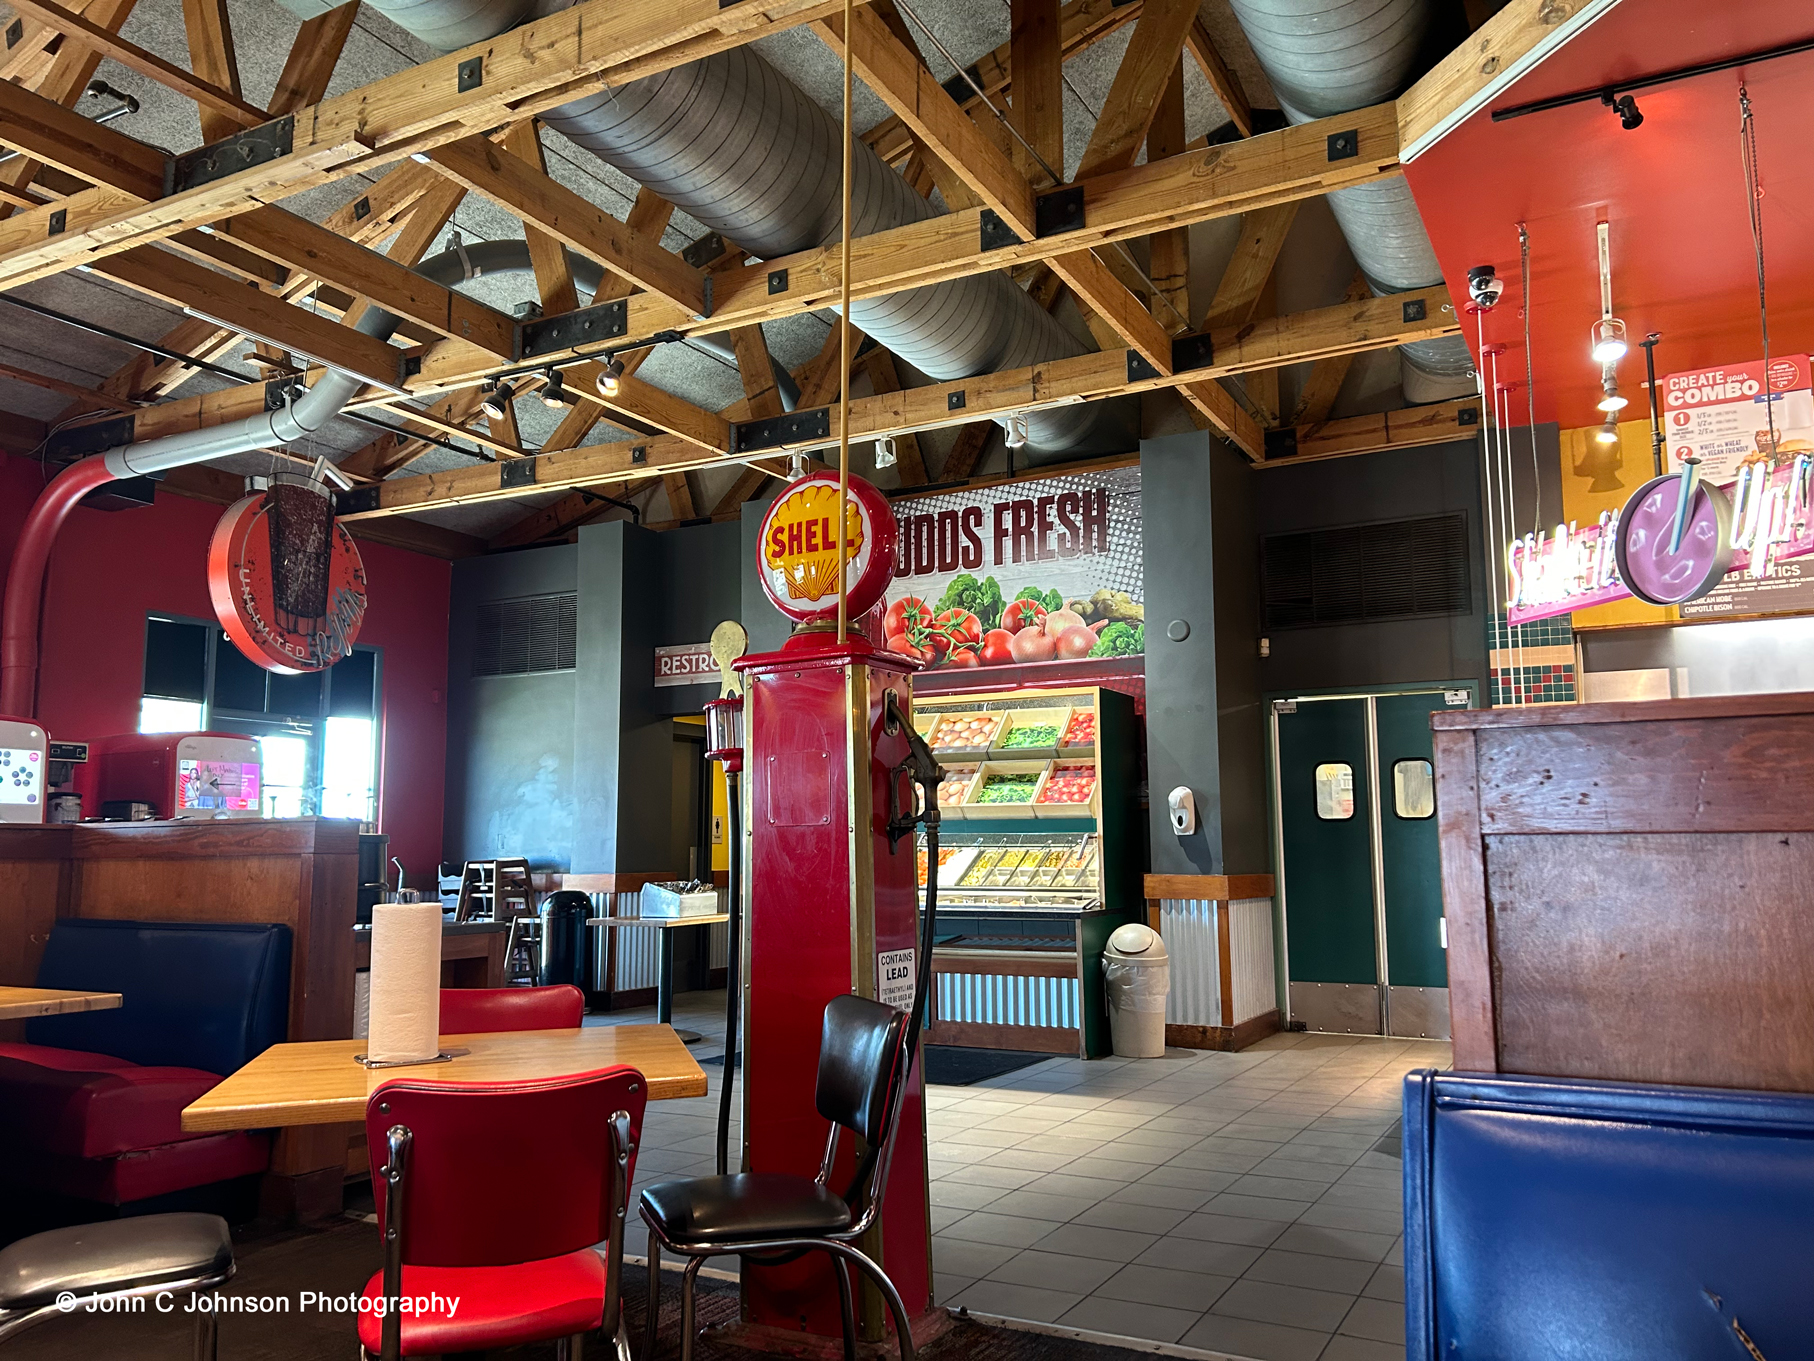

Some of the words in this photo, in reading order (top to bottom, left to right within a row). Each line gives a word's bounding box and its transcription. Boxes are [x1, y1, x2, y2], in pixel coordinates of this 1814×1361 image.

[1669, 371, 1724, 390] CREATE
[1726, 372, 1749, 384] your
[1667, 379, 1760, 406] COMBO
[1678, 413, 1684, 425] 1
[1699, 443, 1715, 451] WHITE
[1724, 439, 1742, 448] WHEAT
[1725, 445, 1749, 454] FRIENDLY
[1680, 448, 1688, 460] 2
[893, 506, 983, 577] UDDS
[993, 488, 1108, 565] FRESH
[1723, 570, 1740, 582] LB
[1743, 564, 1801, 580] ETICS
[239, 568, 305, 658] UNLIMITED
[1684, 605, 1713, 614] CHIPOTLE
[1714, 603, 1733, 611] BISON
[660, 654, 721, 675] RESTRO
[881, 952, 913, 966] CONTAINS
[886, 966, 909, 981] LEAD
[898, 994, 907, 1002] USED
[903, 1002, 913, 1010] ONLY
